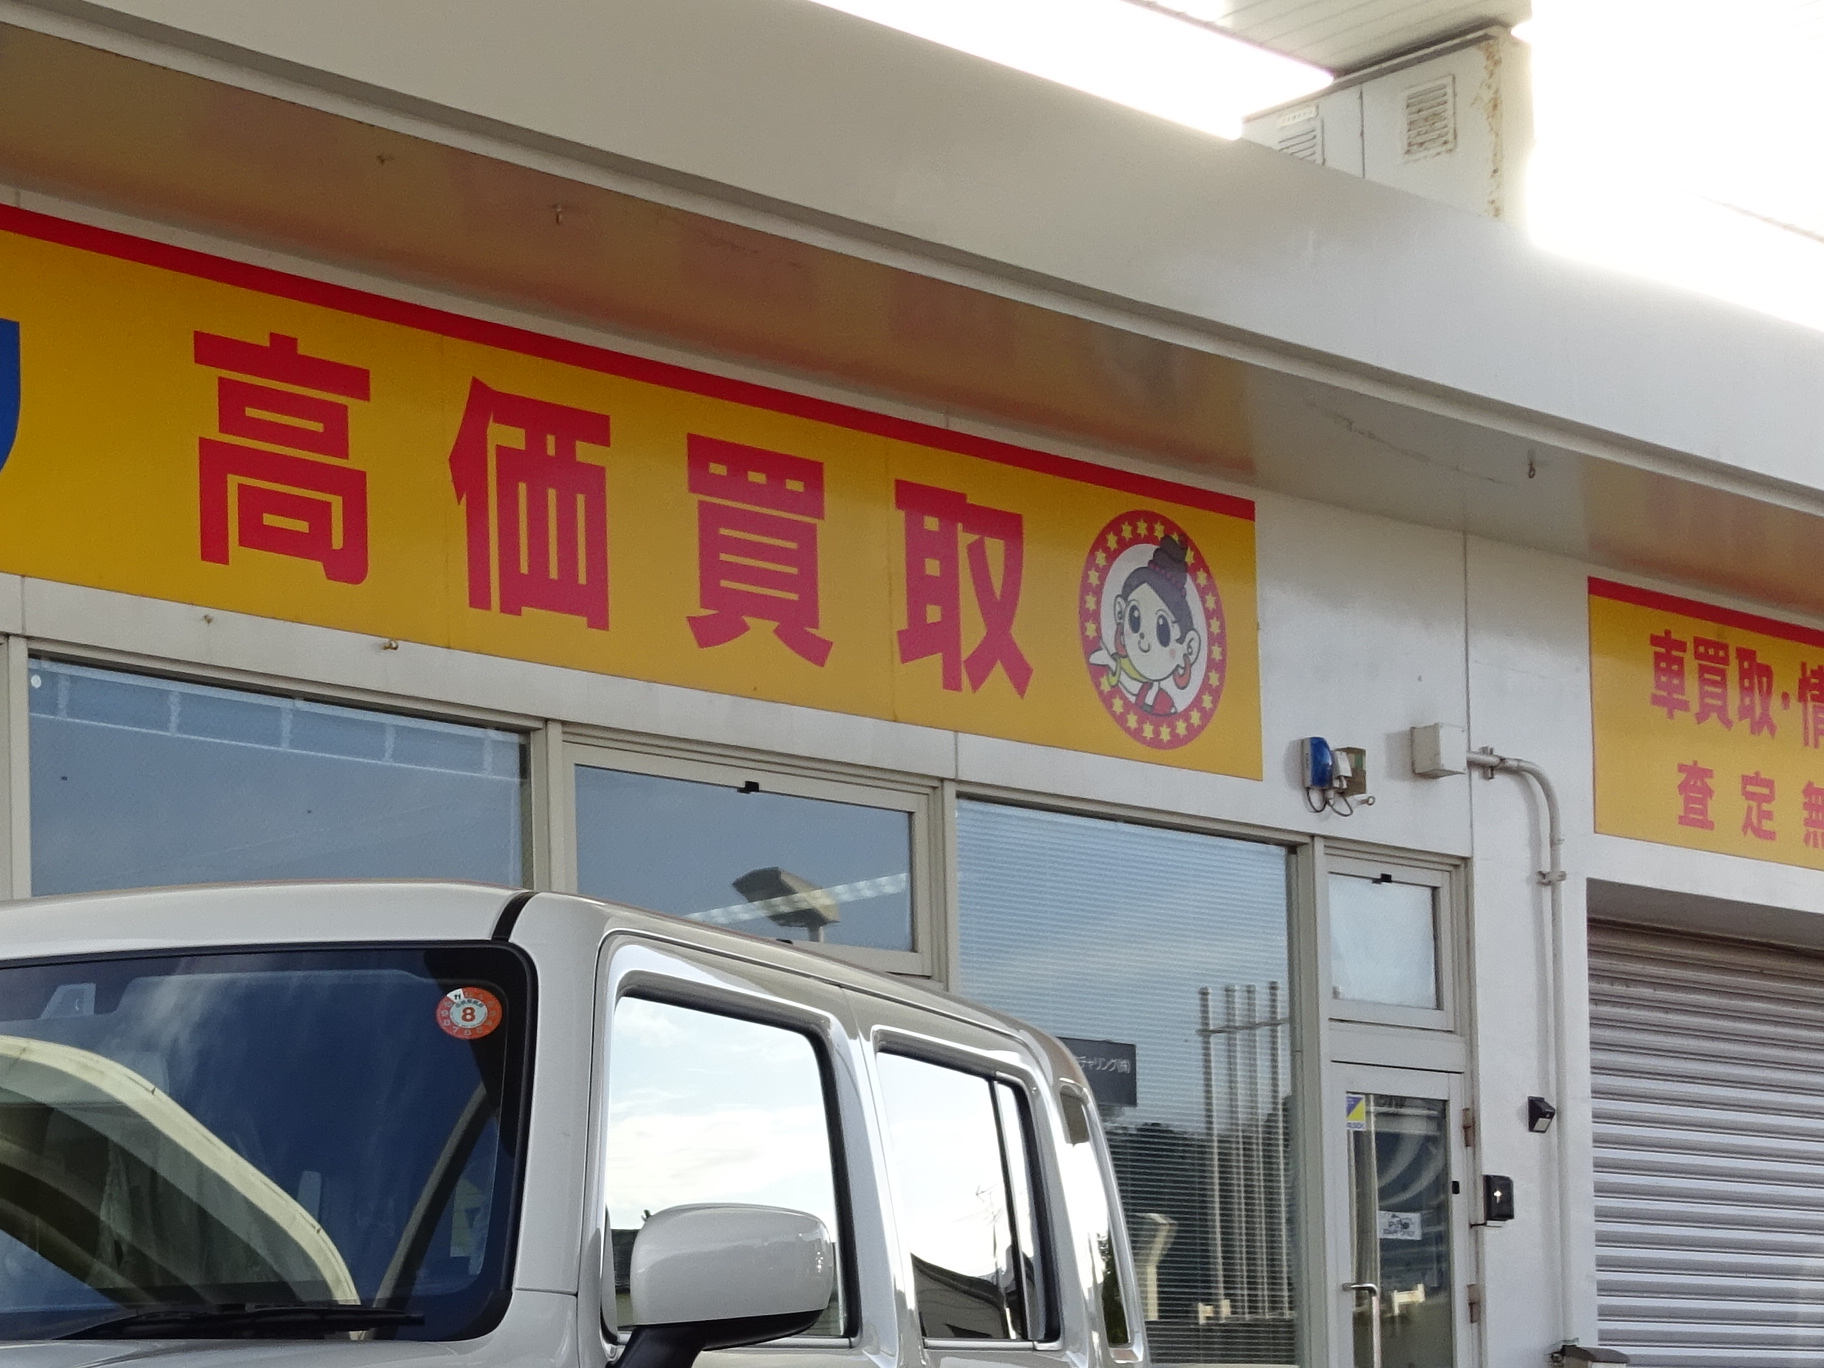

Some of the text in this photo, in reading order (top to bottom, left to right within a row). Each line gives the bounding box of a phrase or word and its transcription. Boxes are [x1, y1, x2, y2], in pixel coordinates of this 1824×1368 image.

[191, 331, 1034, 699] 高価買取
[461, 1007, 475, 1022] 8
